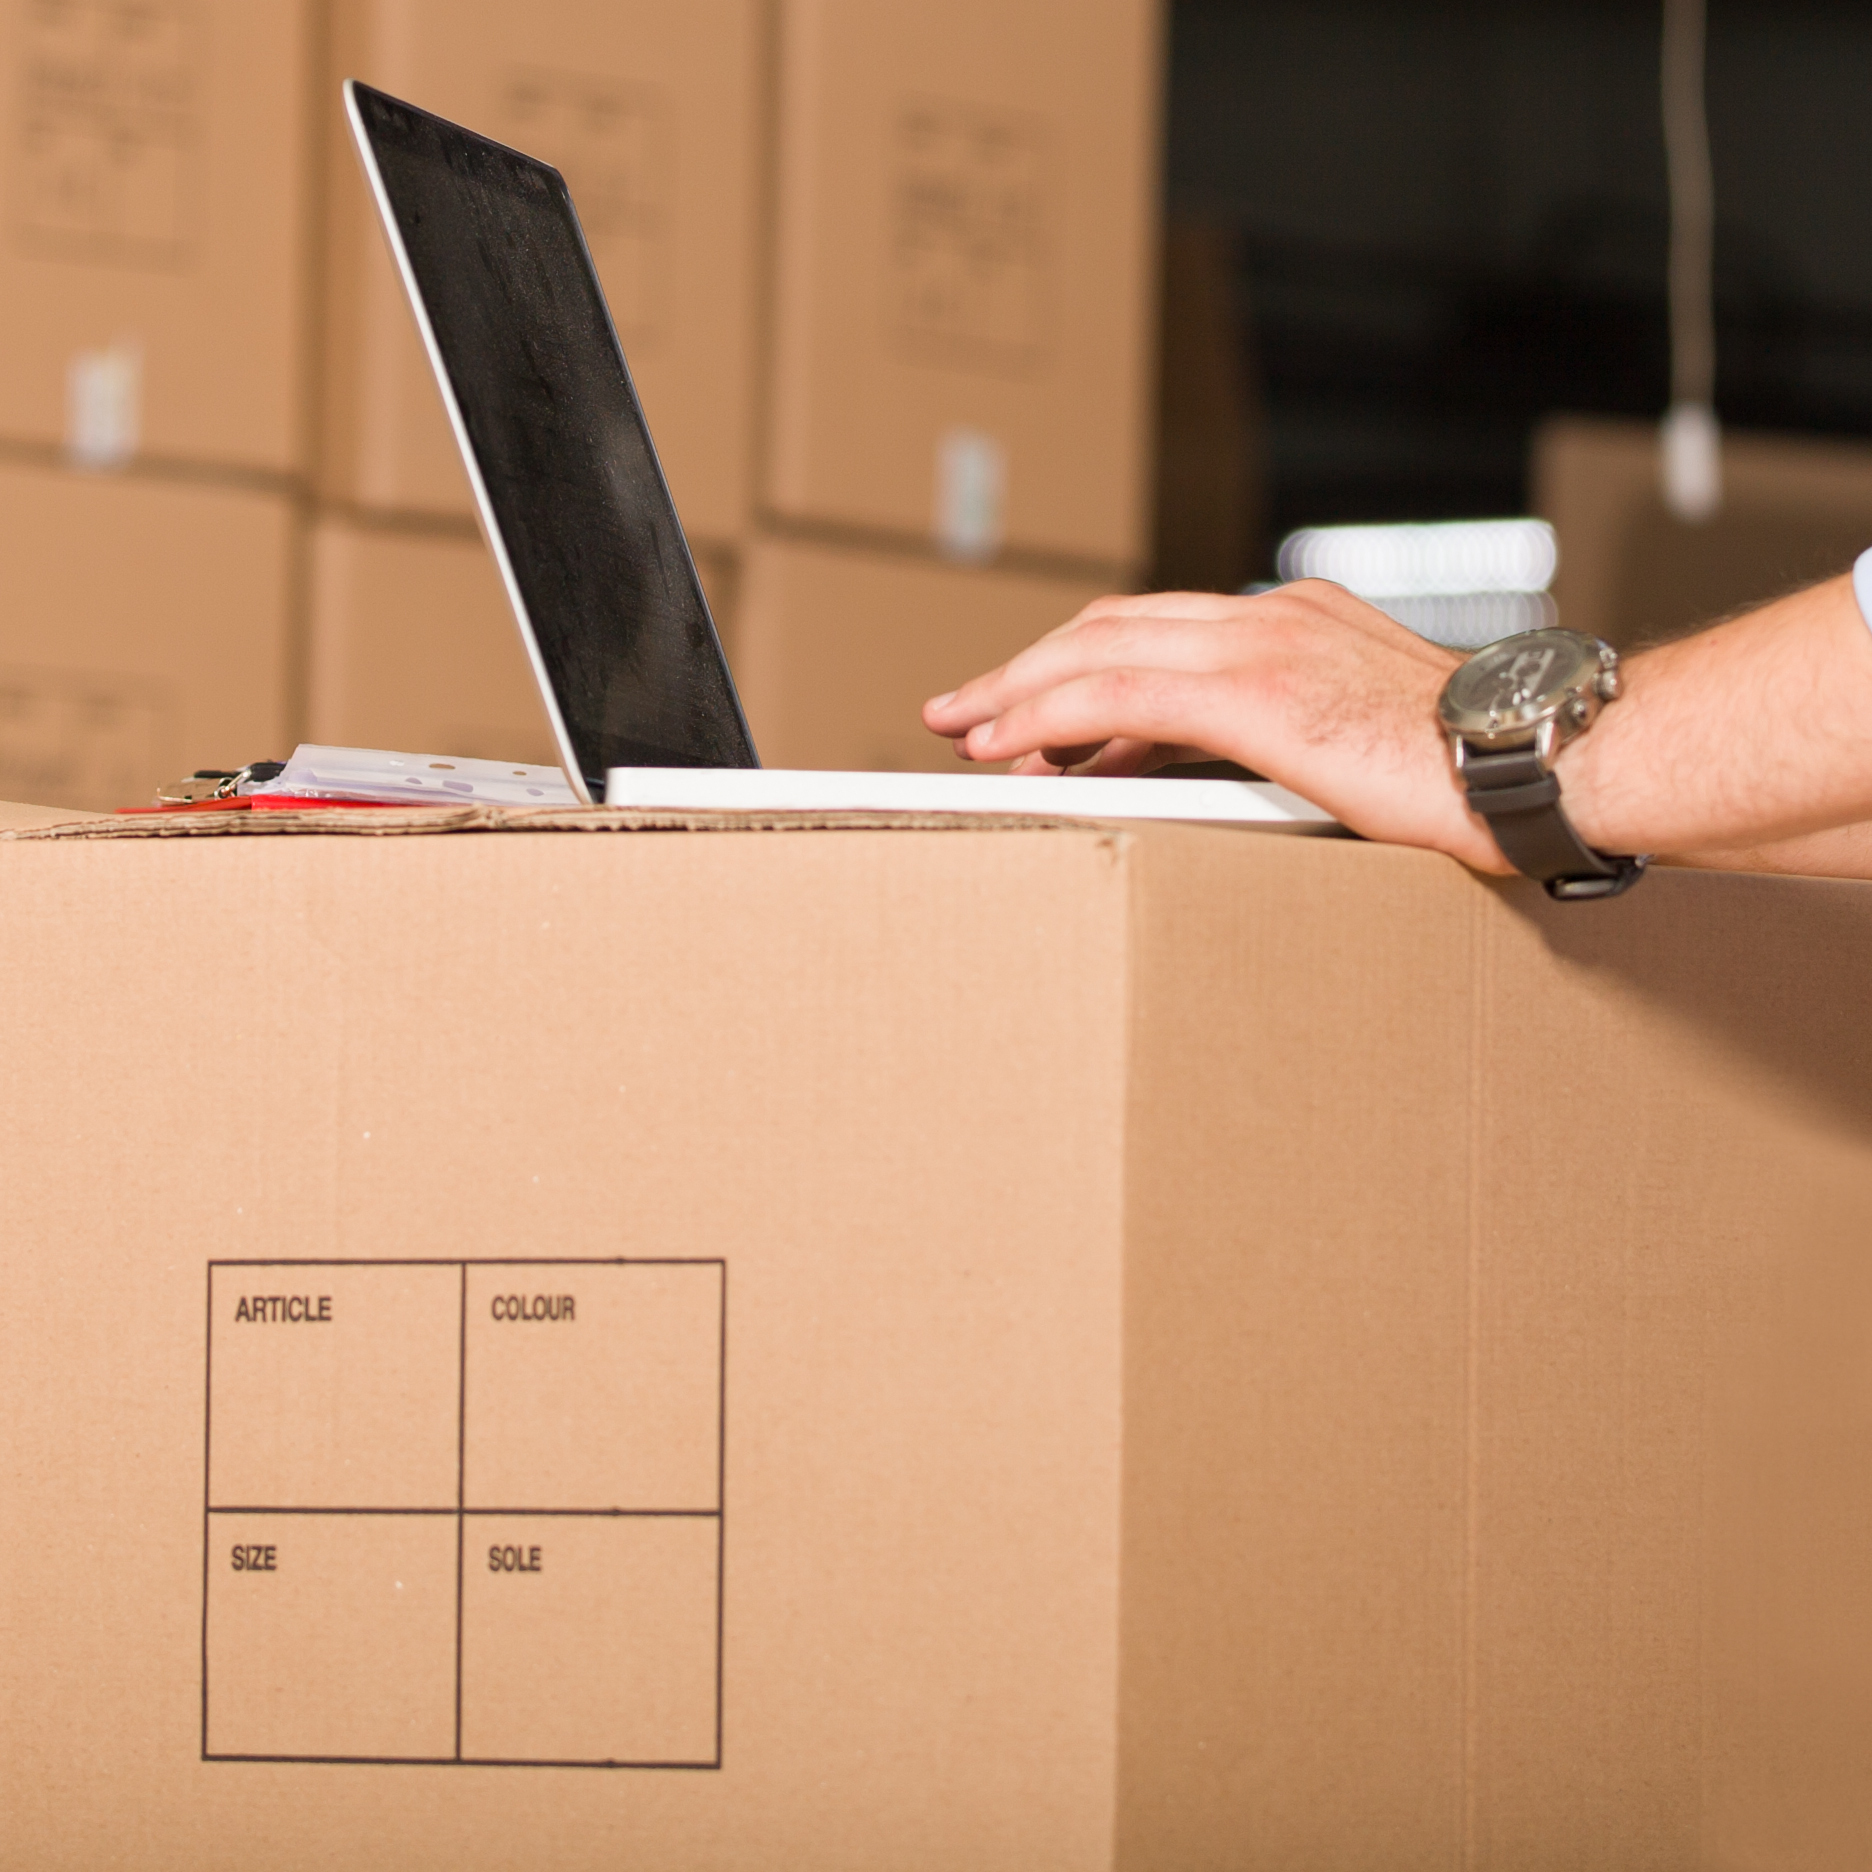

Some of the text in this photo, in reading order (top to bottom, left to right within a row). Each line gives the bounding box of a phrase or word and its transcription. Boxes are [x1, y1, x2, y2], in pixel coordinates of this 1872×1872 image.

[235, 1295, 332, 1323] ARTICLE
[491, 1295, 576, 1322] COLOUR
[231, 1544, 277, 1571] SIZE
[488, 1545, 542, 1572] SOLE
